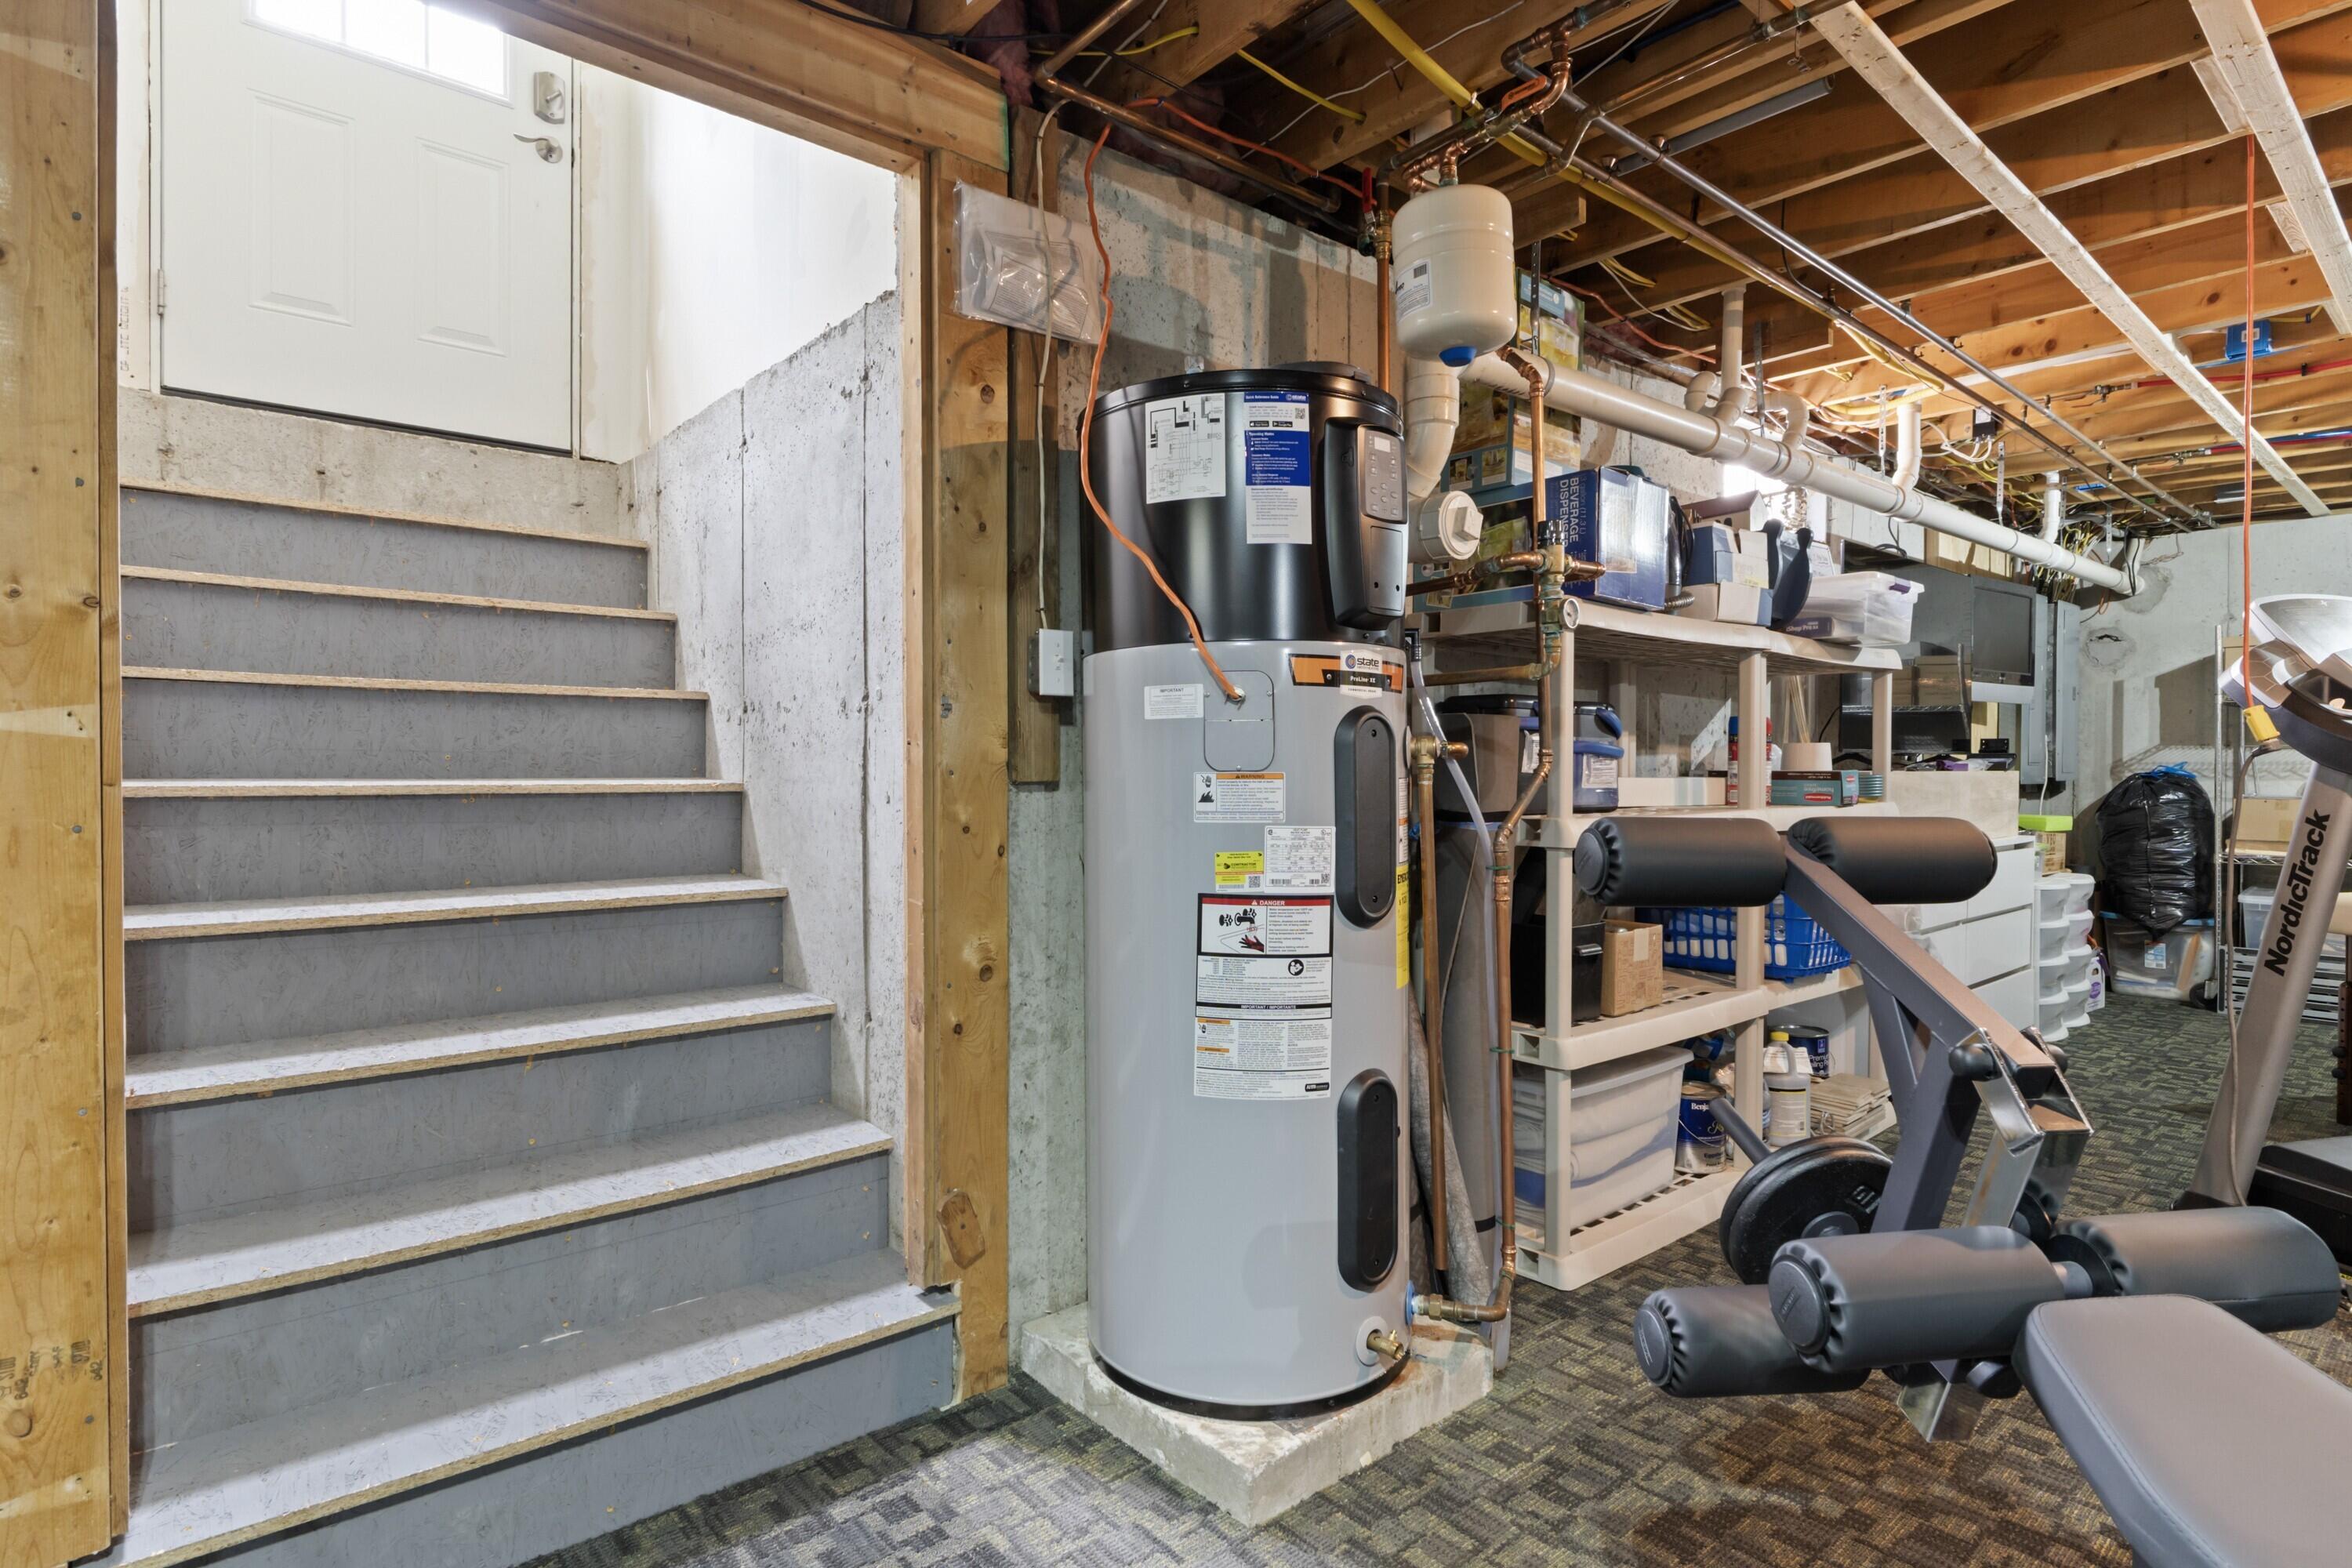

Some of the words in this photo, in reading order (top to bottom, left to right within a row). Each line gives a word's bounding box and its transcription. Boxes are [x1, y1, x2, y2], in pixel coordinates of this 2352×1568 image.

[1569, 476, 1580, 543] BEVERAGE
[1356, 657, 1380, 667] state
[2263, 808, 2332, 978] NordicTrack
